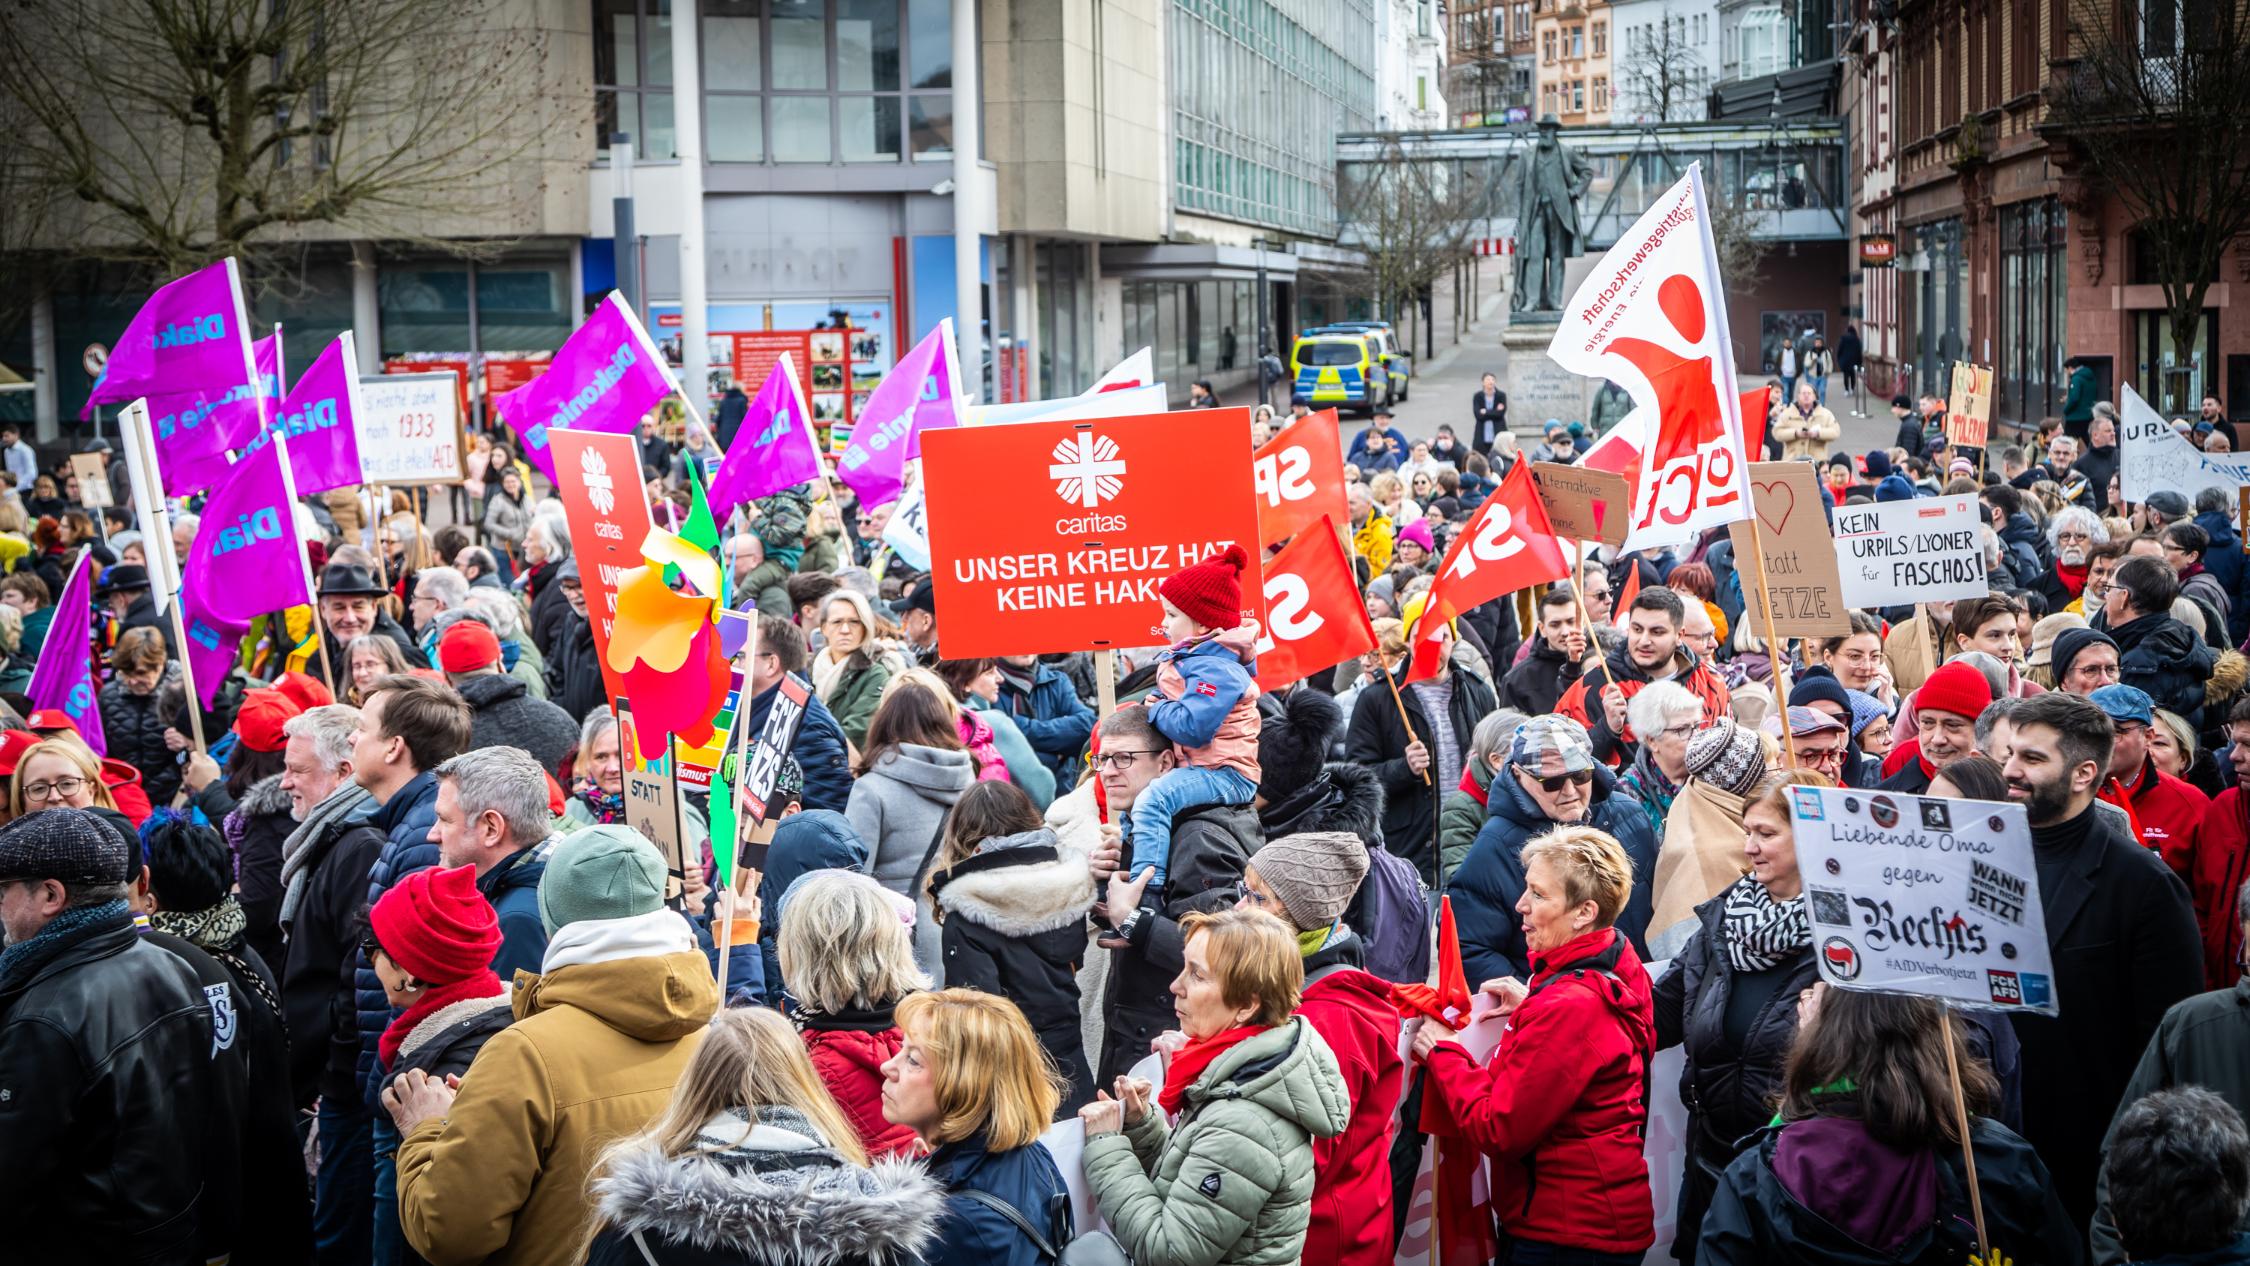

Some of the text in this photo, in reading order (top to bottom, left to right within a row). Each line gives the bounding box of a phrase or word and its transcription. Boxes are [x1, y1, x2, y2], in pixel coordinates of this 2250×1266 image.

[399, 413, 434, 438] 1933
[1532, 472, 1601, 497] Alternative
[1056, 512, 1127, 535] caritas
[1838, 512, 1880, 534] KEIN
[1852, 530, 1974, 558] URPILS/LYONER
[954, 553, 1058, 583] UNSER
[1067, 545, 1169, 575] KREUZ
[1763, 552, 1802, 575] tatt
[1861, 552, 1985, 587] für FASCHOS!
[996, 582, 1086, 612] KEINE
[763, 690, 802, 755] FCK
[743, 739, 782, 802] NZS
[631, 778, 662, 807] STATT
[1831, 823, 1995, 854] Liebende Oma
[1882, 865, 1944, 888] gegen
[1972, 859, 2028, 897] WANN
[1968, 887, 2024, 923] JETZT
[1851, 895, 1988, 960] Rechts
[1989, 974, 2018, 988] FCK
[1992, 986, 2020, 999] AFD
